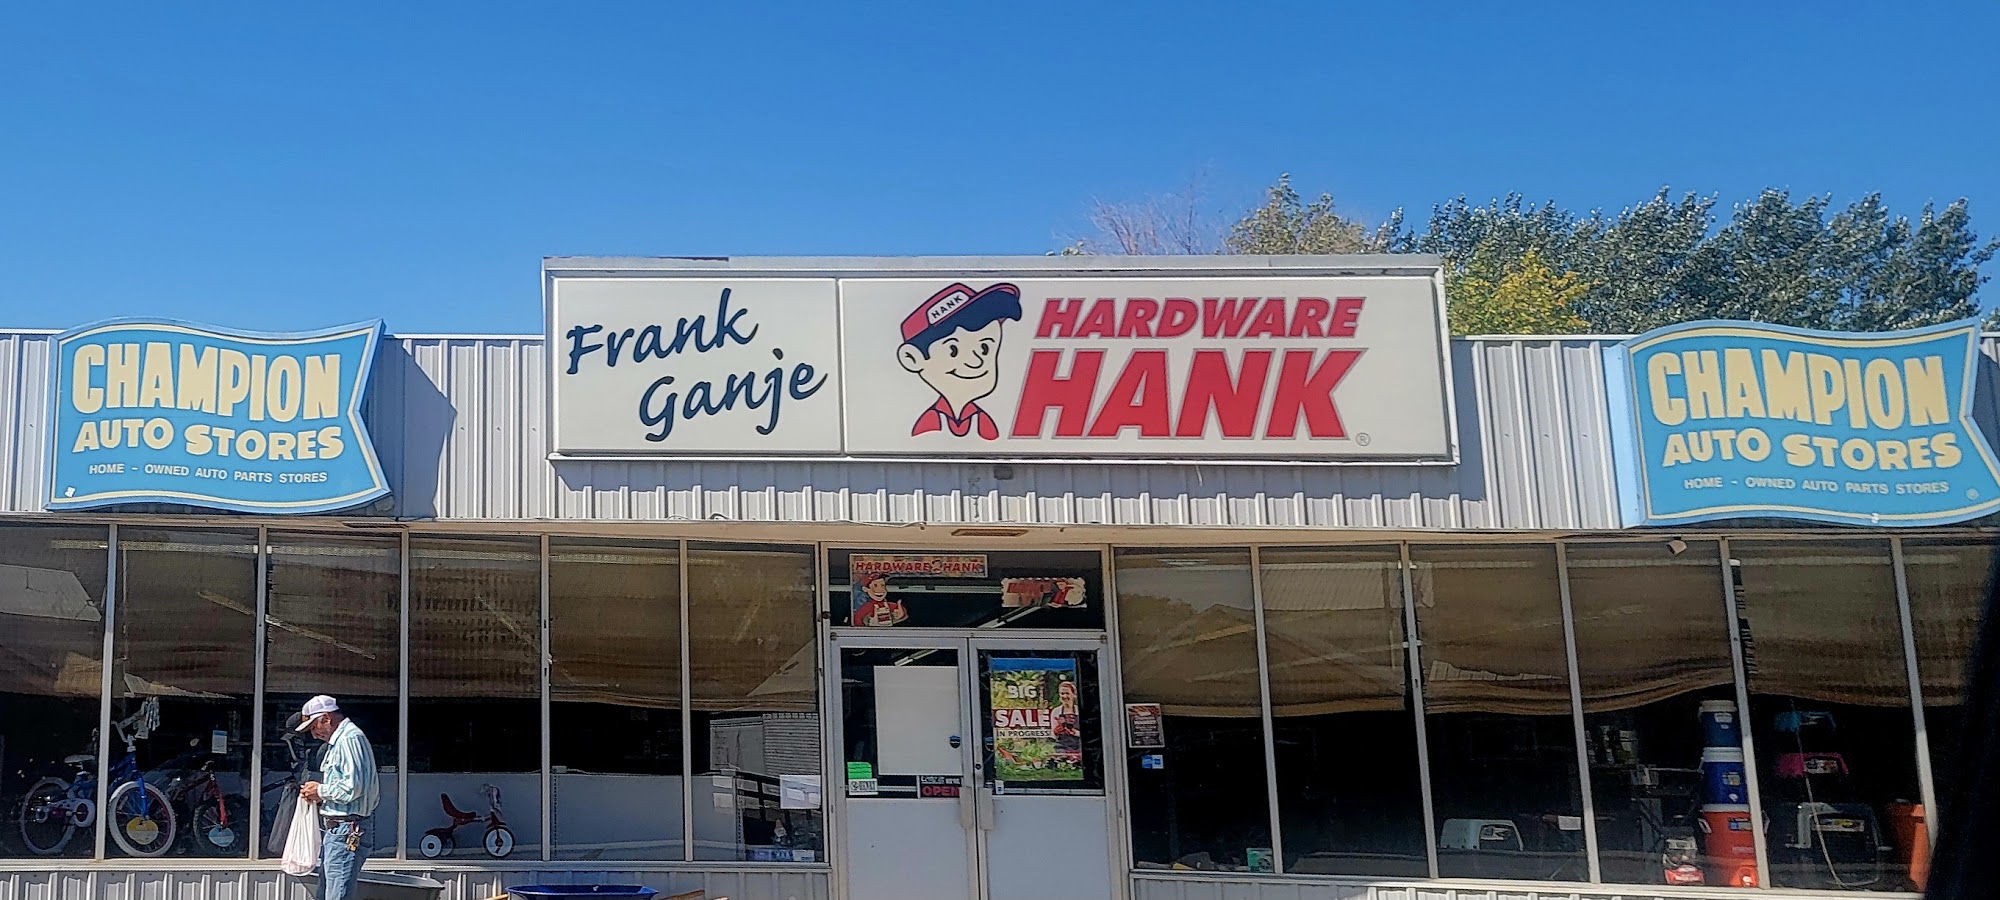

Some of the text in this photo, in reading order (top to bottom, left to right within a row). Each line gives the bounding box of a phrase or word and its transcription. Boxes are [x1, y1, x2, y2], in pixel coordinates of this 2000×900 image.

[931, 295, 963, 318] HANK
[1034, 296, 1366, 340] HARDWARE
[566, 288, 759, 374] Frank
[72, 342, 340, 422] CHAMPION
[638, 348, 828, 442] Ganje
[1008, 348, 1368, 440] HANK
[1648, 348, 1950, 430] CHAMPION
[72, 418, 344, 461] AUTO STORES
[1662, 428, 1963, 471] AUTO STORES
[89, 464, 124, 474] HOME
[144, 464, 190, 476] OWNED
[195, 468, 228, 480] AUTO
[234, 471, 272, 483] PARTS
[279, 472, 328, 483] STORES
[1684, 477, 1723, 490] HOME
[1744, 477, 1796, 490] OWNED
[1802, 480, 1838, 492] AUTO
[1845, 482, 1889, 494] PARTS
[1895, 482, 1950, 494] STORES
[856, 562, 980, 572] HARDWARE HANK
[1007, 685, 1037, 698] BIG
[995, 710, 1050, 727] SALE
[922, 786, 960, 796] OPEN
